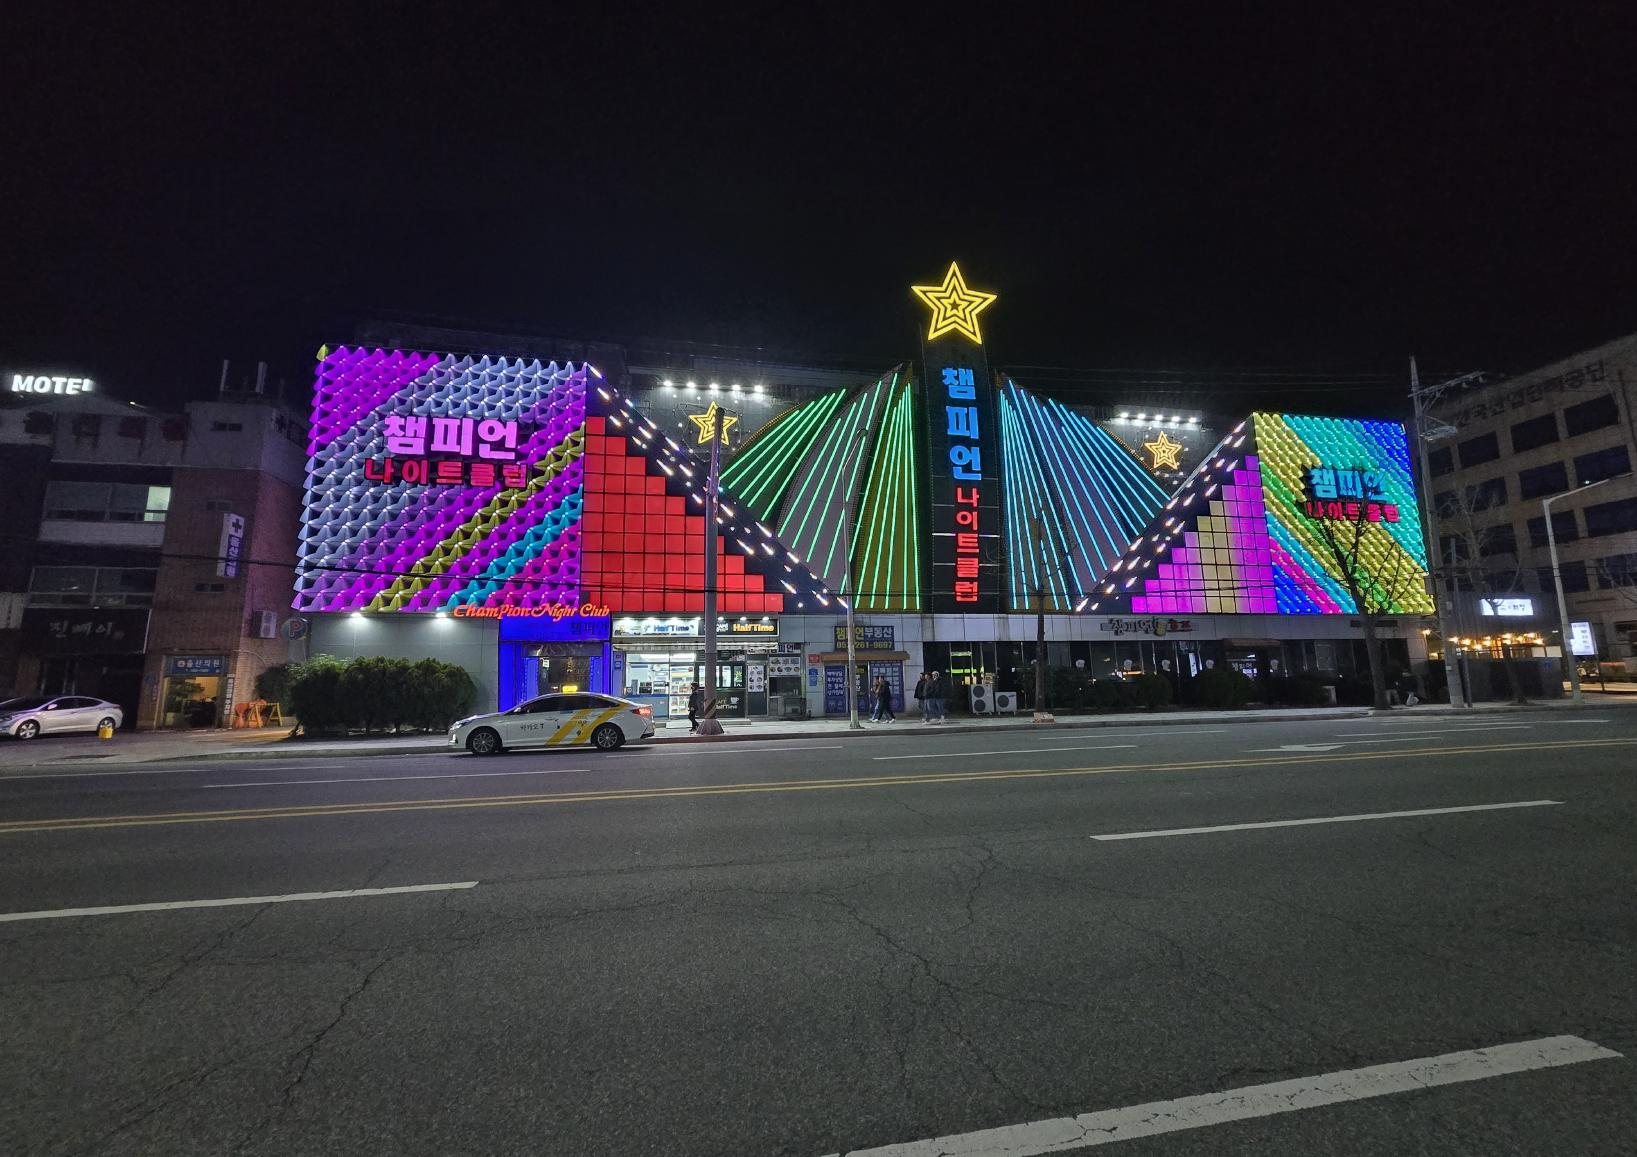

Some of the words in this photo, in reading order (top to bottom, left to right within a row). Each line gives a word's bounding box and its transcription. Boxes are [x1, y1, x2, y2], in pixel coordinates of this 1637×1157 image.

[383, 415, 518, 460] 챔피언
[942, 368, 981, 480] 챔피언
[364, 457, 529, 489] 나이트클럽
[1309, 468, 1389, 500] 챔피언
[955, 486, 980, 602] 나이트클럽
[531, 602, 577, 622] Night
[579, 603, 610, 617] Club
